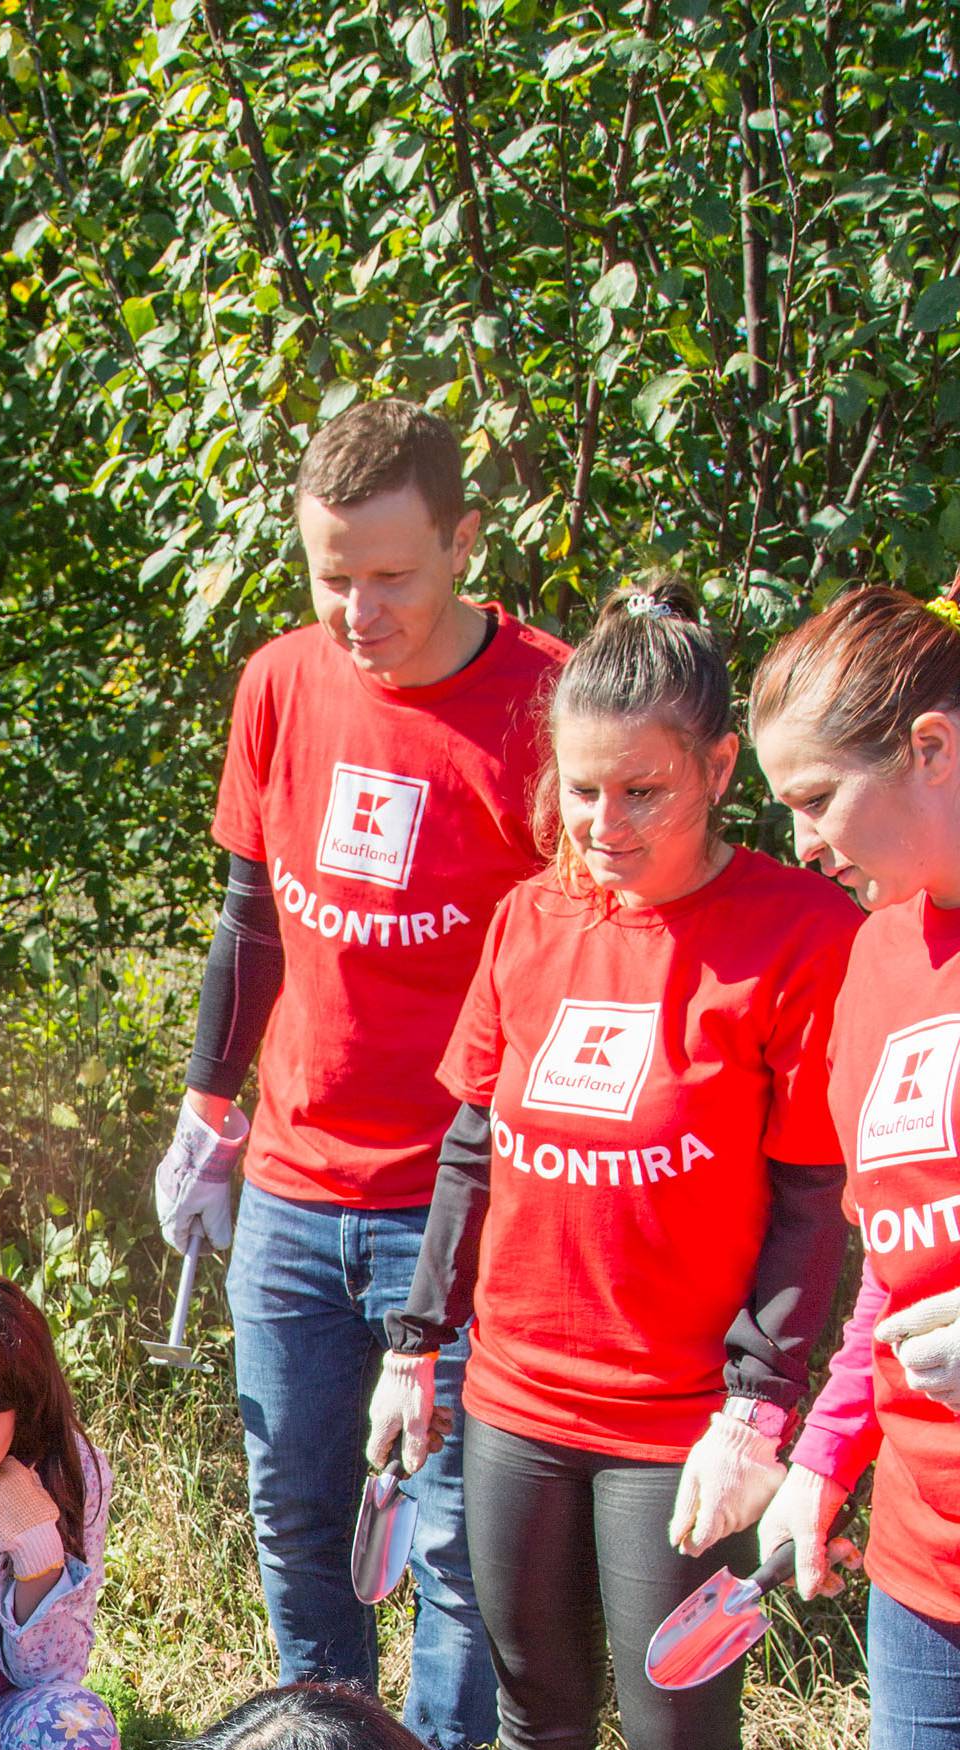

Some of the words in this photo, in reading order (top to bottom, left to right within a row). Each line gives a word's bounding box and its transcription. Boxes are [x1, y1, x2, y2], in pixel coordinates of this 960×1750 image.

[331, 838, 398, 865] Kaufland
[273, 857, 471, 948] VOLONTIRA
[544, 1069, 626, 1095] Kaufland
[867, 1110, 935, 1139] Kaufland
